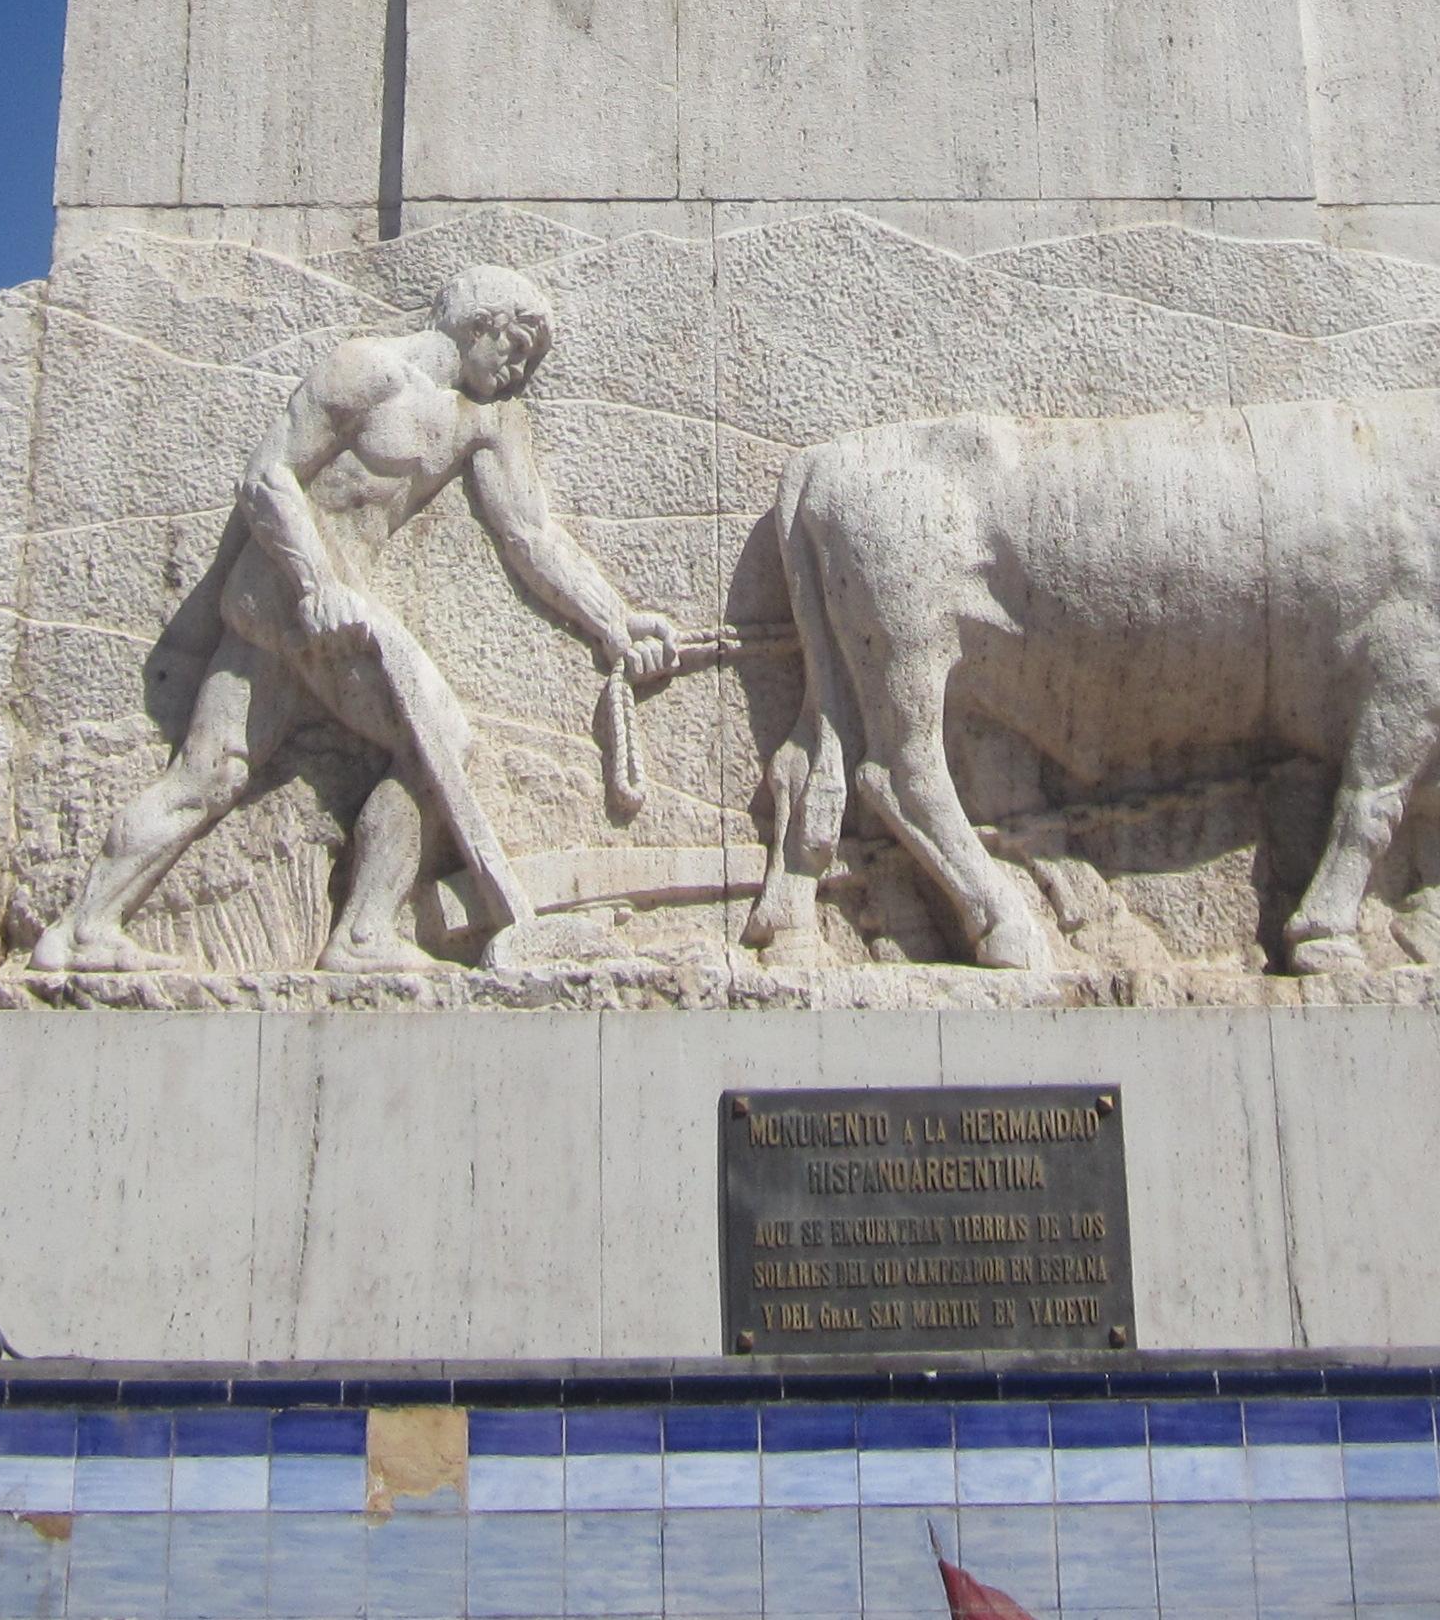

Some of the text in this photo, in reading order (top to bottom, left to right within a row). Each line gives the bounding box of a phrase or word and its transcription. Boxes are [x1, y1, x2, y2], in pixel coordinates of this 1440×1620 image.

[749, 1108, 1099, 1148] MONUMENTO A LA HERMANDAD
[807, 1155, 1045, 1194] HISPANOARGENTINA
[754, 1213, 1105, 1249] AQUI SE ENCUENTRAN TIERRAS DE LOS
[752, 1255, 1108, 1289] SOLARES DEL CID CAMPEADOR EN ESPAÑA
[760, 1304, 775, 1331] Y
[780, 1302, 813, 1330] DEL
[870, 1299, 905, 1329] SAN
[912, 1299, 980, 1327] MARTIN
[993, 1299, 1016, 1326] EN
[1028, 1296, 1100, 1325] YAPEYU
